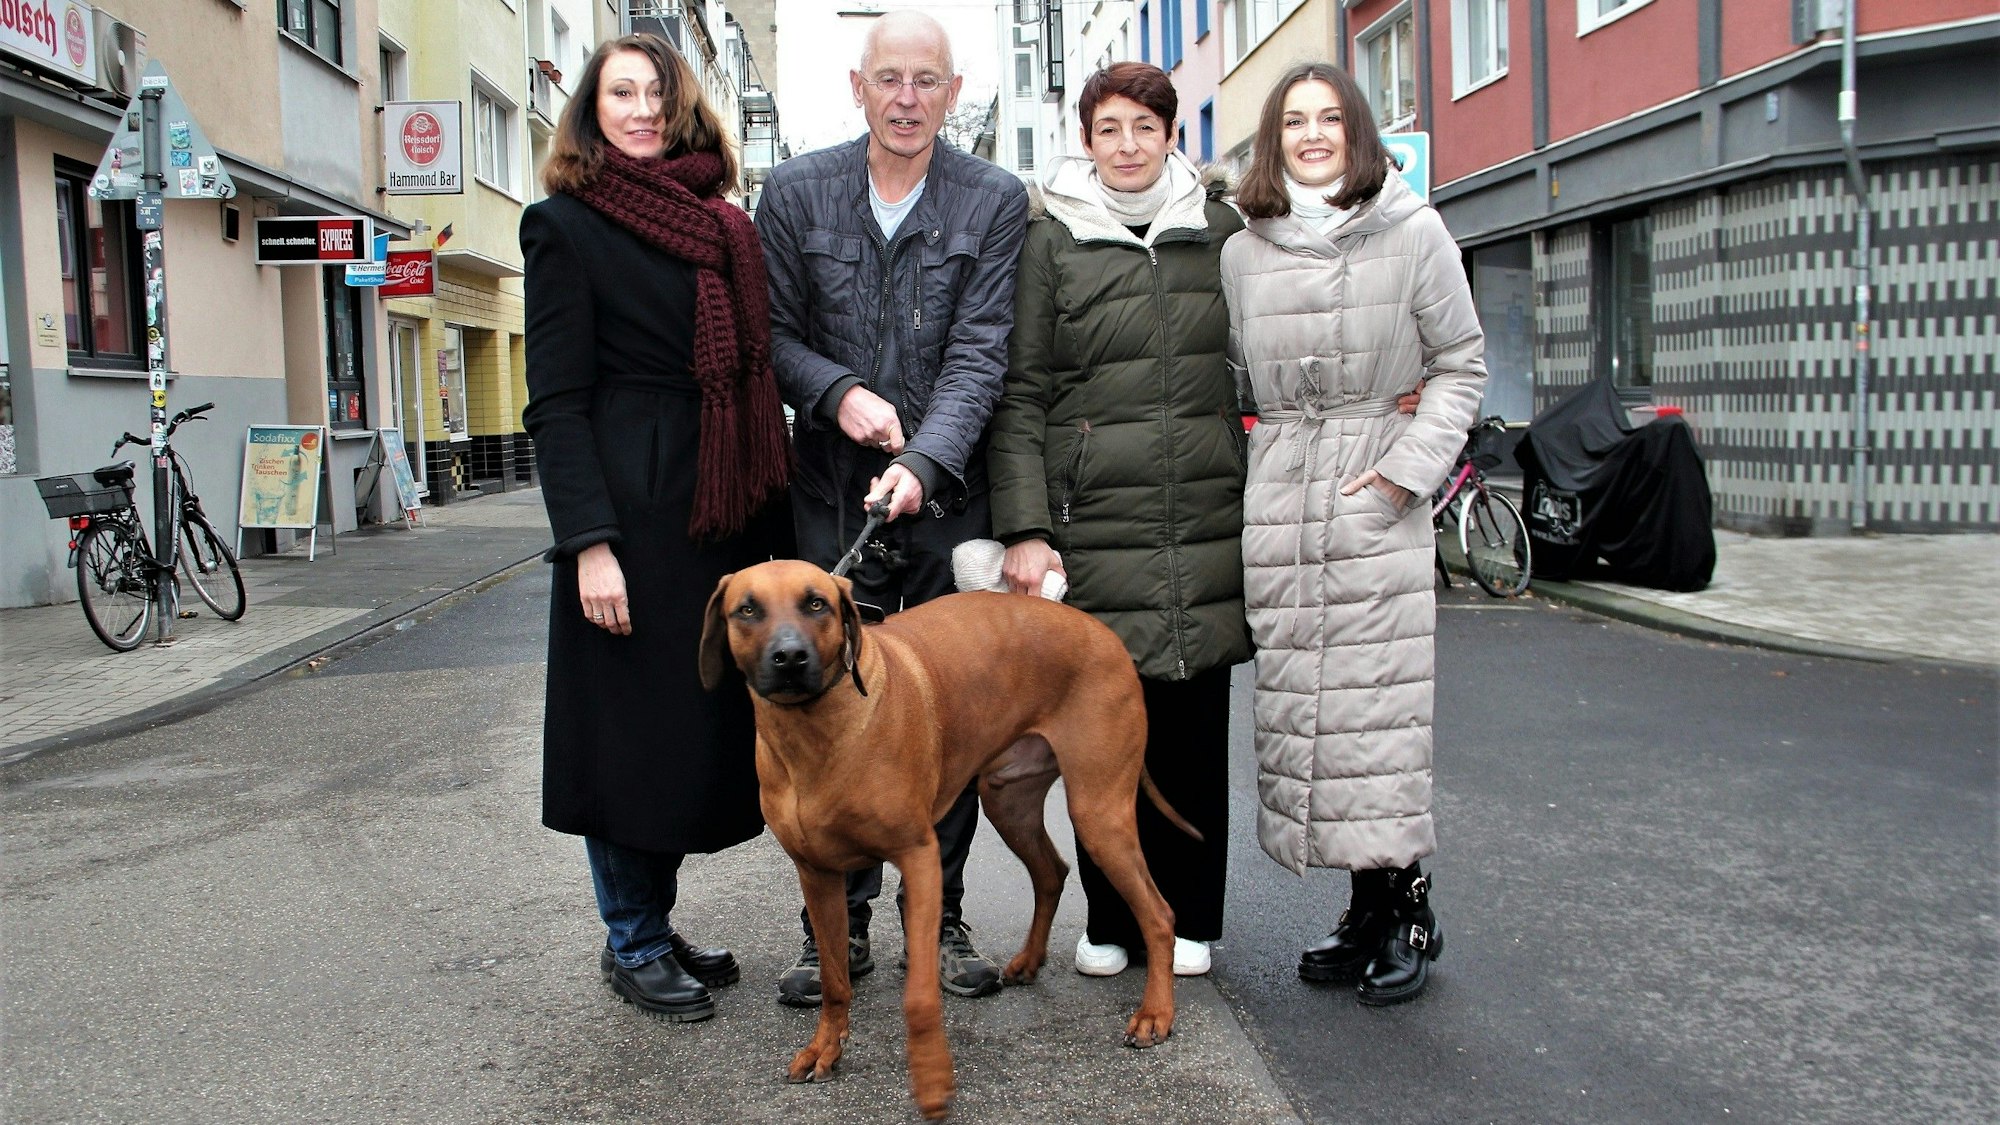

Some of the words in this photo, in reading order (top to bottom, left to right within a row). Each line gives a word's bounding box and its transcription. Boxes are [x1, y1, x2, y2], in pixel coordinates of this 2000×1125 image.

[404, 134, 440, 144] Reissdorf
[389, 171, 437, 187] Hammond
[440, 170, 457, 186] Bar
[136, 195, 144, 205] S
[320, 228, 353, 252] EXPRESS
[354, 276, 384, 284] PaketShop
[253, 433, 296, 443] Sodafixx
[259, 457, 285, 465] Zischen
